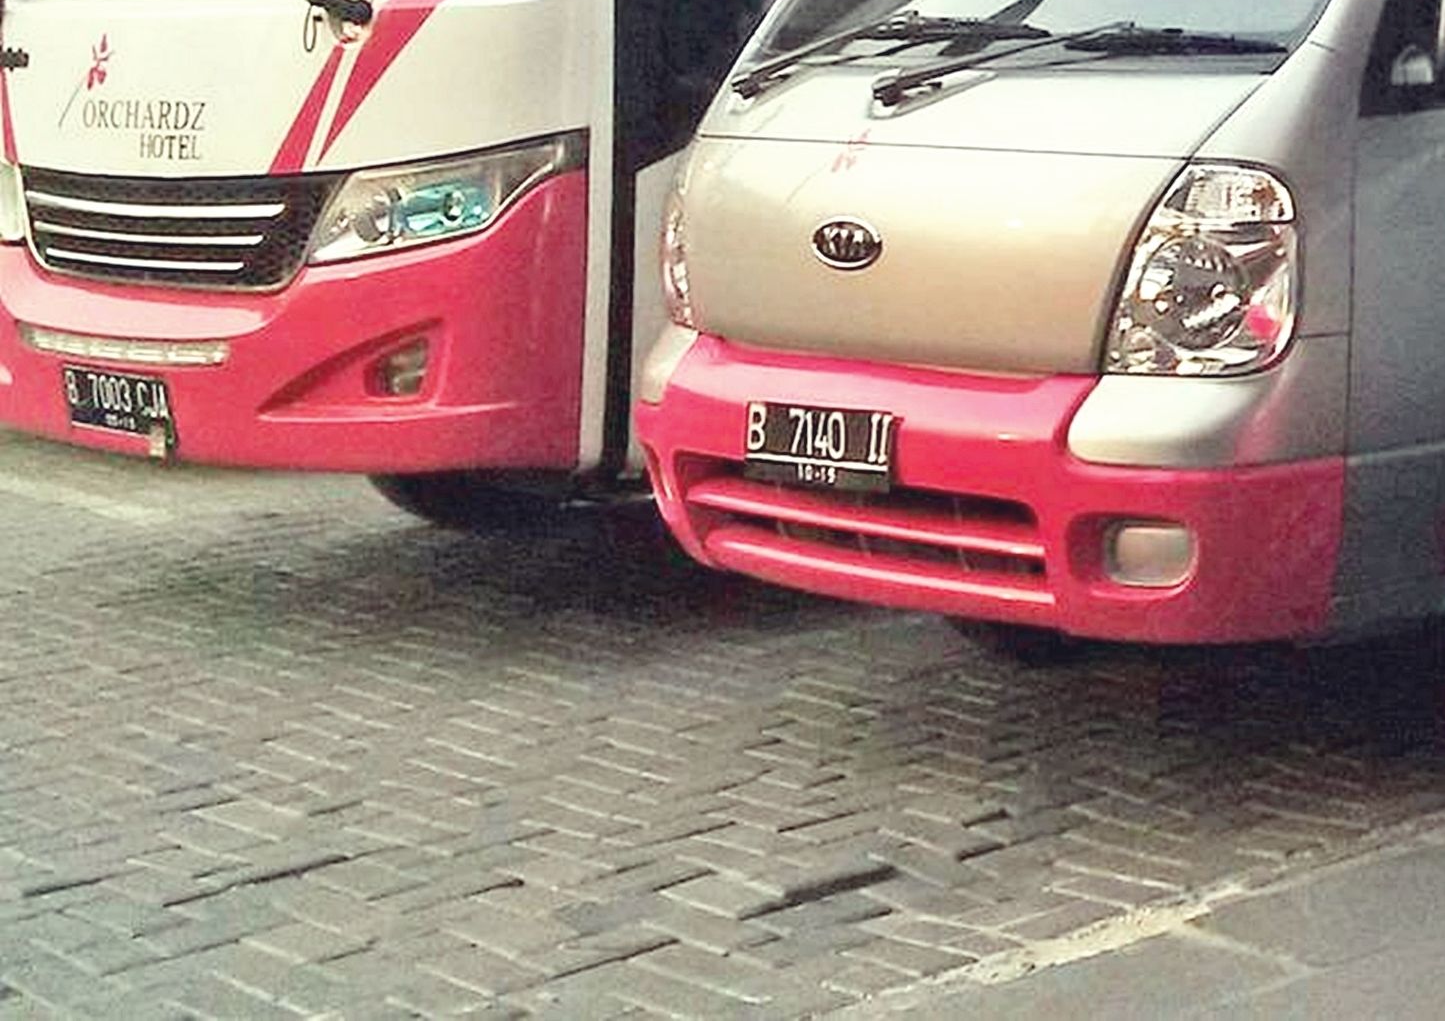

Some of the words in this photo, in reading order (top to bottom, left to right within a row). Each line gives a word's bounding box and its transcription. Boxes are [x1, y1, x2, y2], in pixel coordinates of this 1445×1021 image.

[82, 99, 206, 131] ORCHARDZ
[139, 133, 204, 160] HOTEL
[87, 373, 133, 413] 7003
[746, 402, 768, 451] B
[788, 407, 846, 460] 7140
